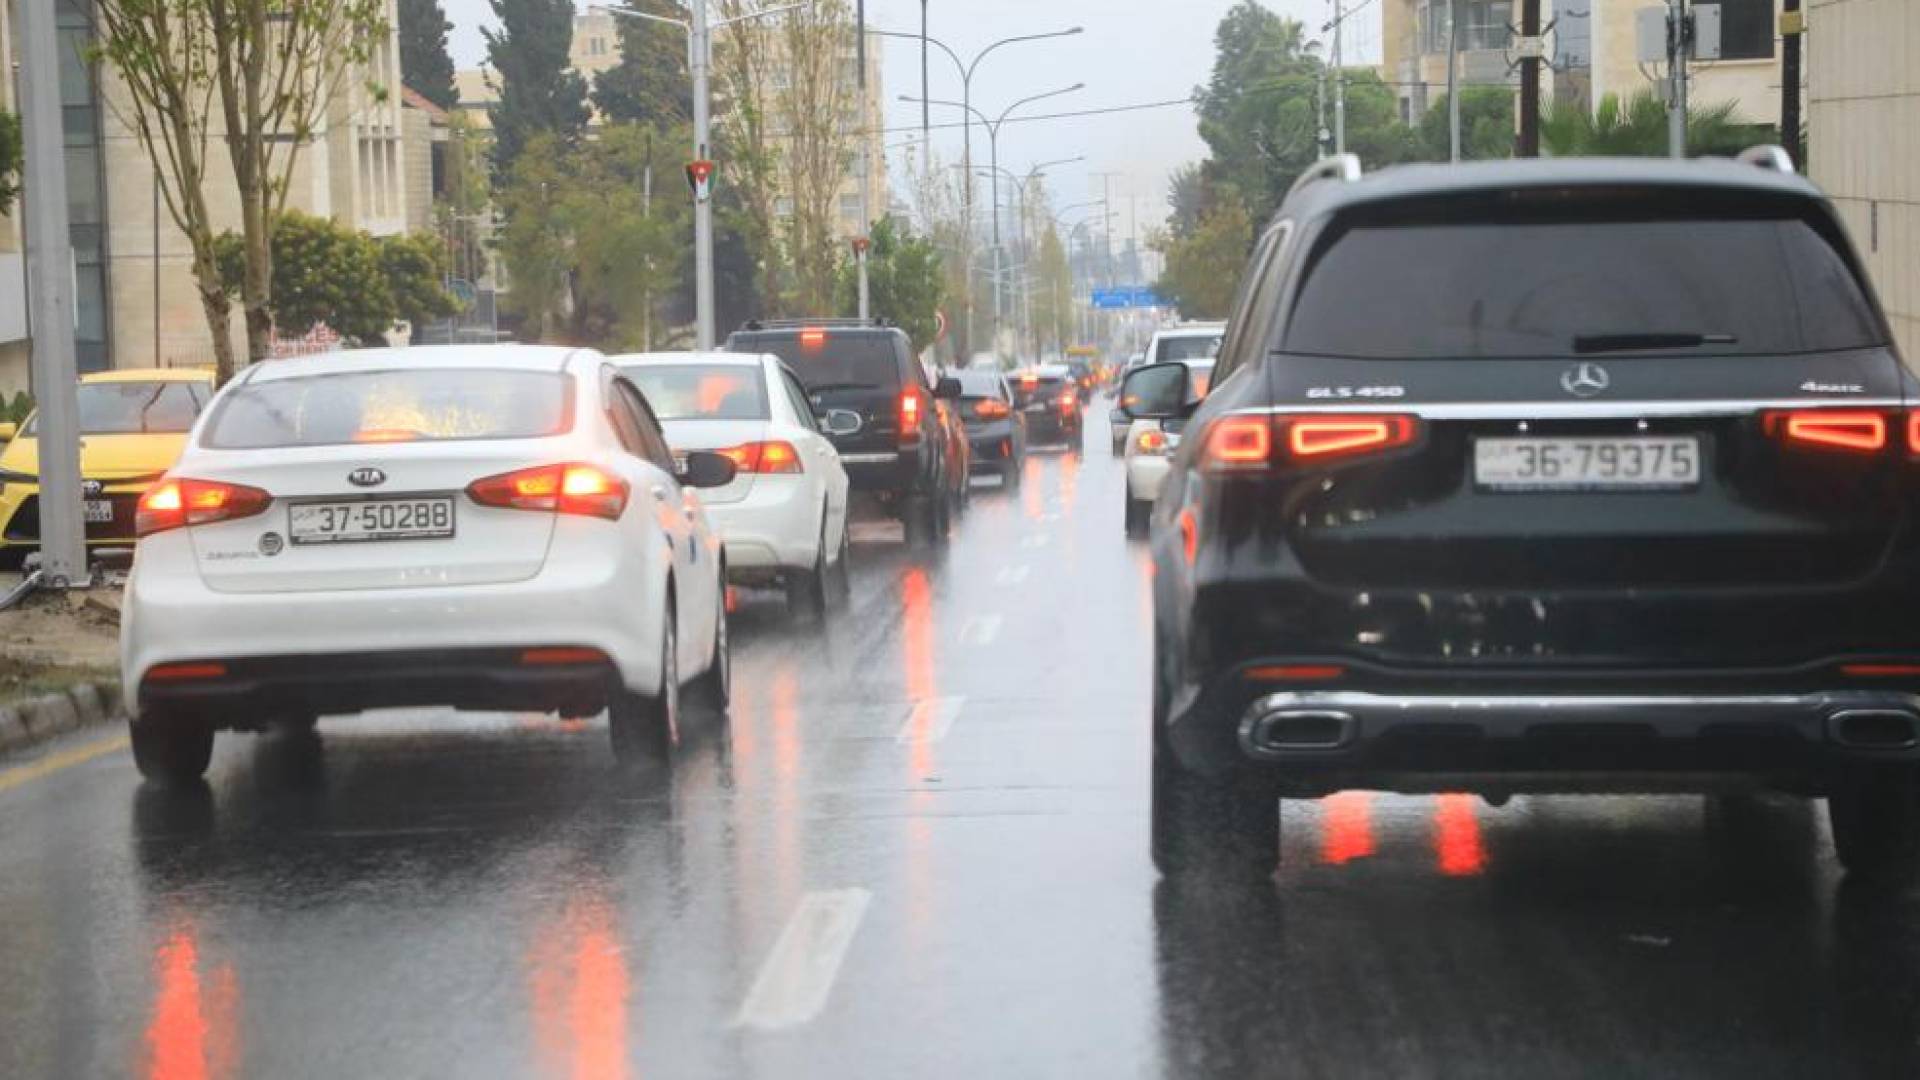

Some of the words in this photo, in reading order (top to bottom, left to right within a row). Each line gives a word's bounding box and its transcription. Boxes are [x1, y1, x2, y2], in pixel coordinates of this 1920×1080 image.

[1355, 386, 1405, 397] 450
[1516, 444, 1693, 477] 36-79375
[352, 469, 383, 484] KIA
[319, 502, 449, 532] 37-50288
